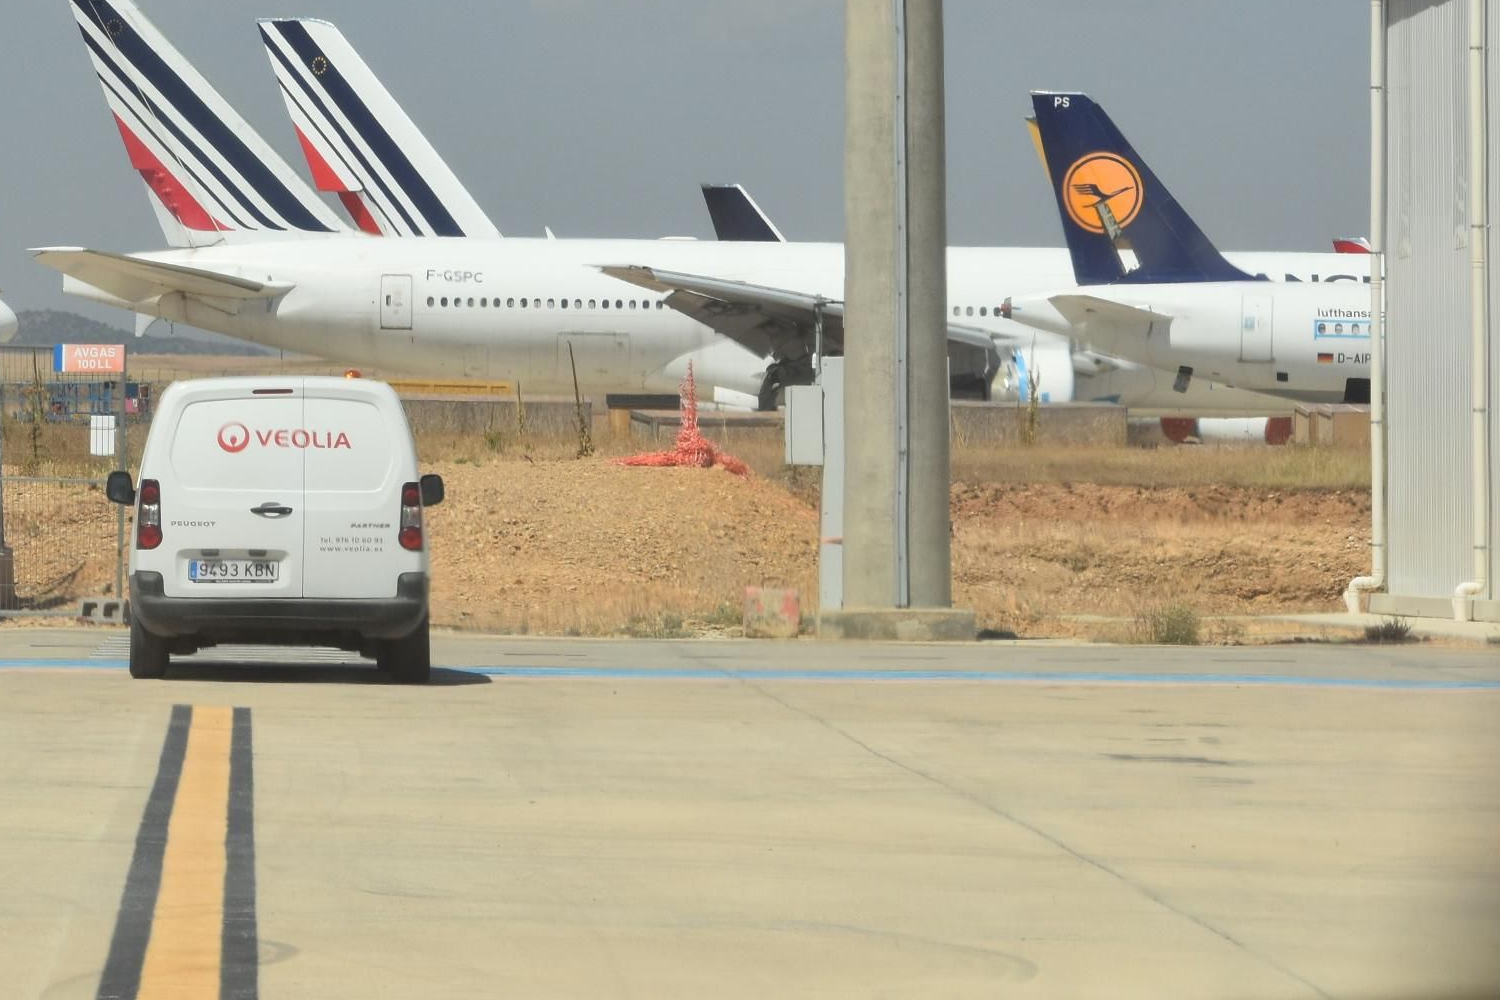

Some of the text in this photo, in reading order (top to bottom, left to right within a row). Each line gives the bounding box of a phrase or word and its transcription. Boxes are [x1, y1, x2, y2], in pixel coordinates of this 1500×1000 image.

[1054, 96, 1070, 108] PS
[426, 269, 483, 283] F-GSPC
[74, 347, 116, 358] AVGAS
[255, 430, 351, 449] VEOLIA
[199, 563, 275, 577] 9493 KBN
